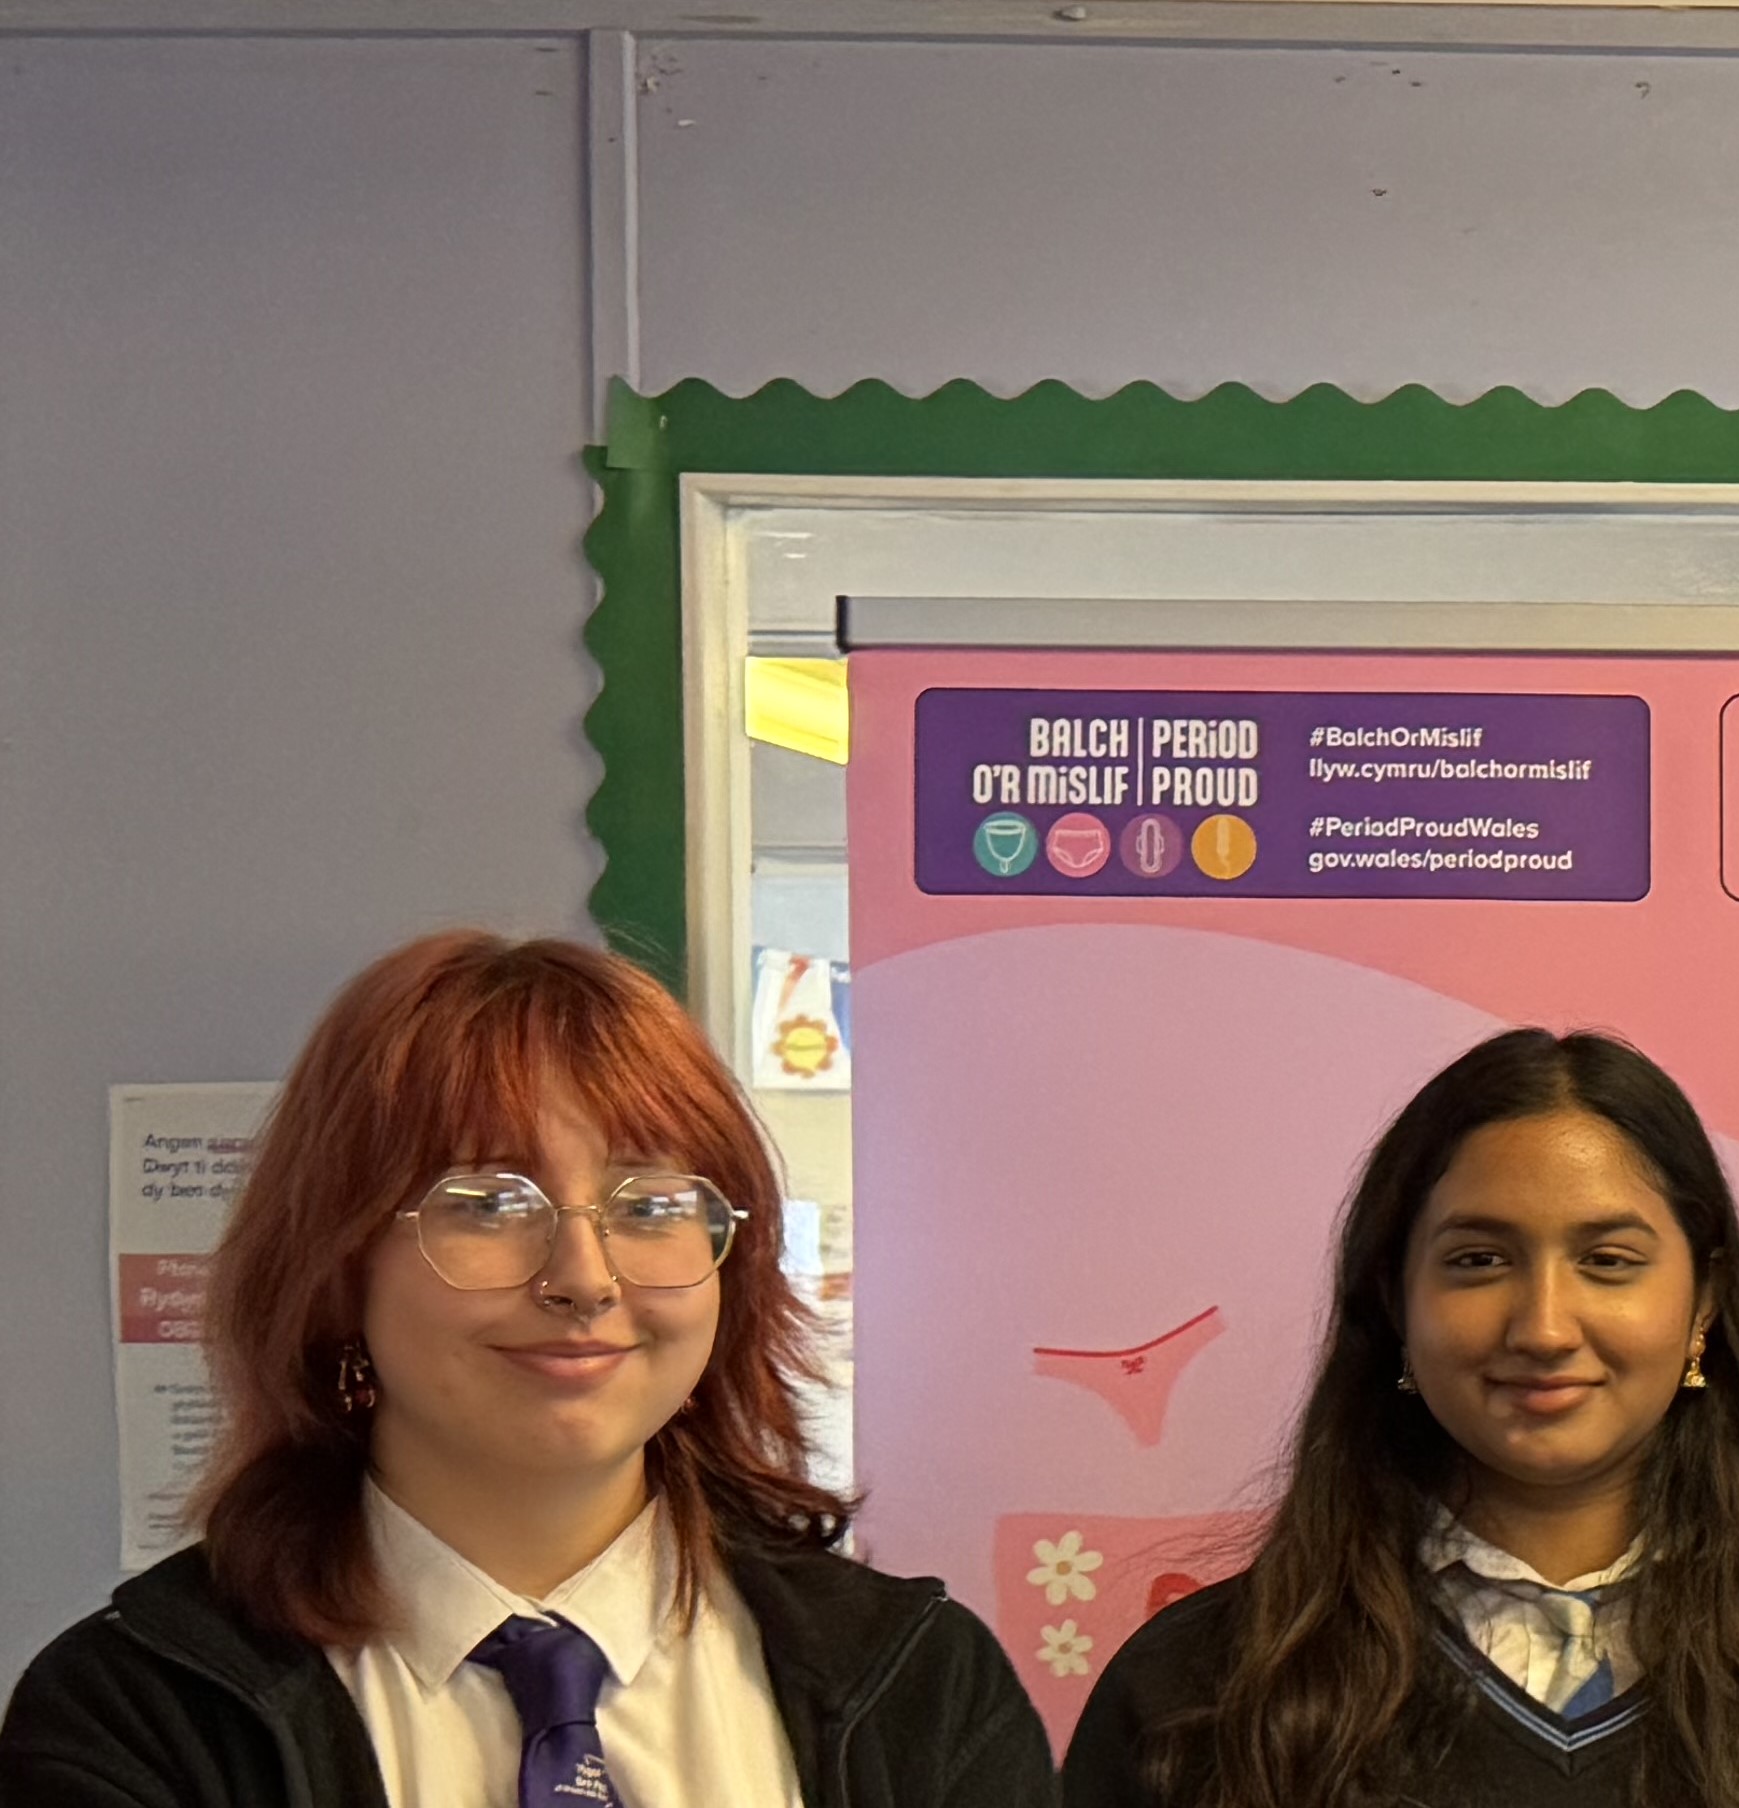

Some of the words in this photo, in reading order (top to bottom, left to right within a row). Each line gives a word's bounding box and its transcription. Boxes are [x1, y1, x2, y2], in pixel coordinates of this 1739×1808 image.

[1030, 718, 1128, 757] BALCH
[1310, 727, 1482, 747] #BalchOrMislif
[1310, 759, 1591, 782] llyw.cymru/balchormislif
[1152, 767, 1257, 806] PROUD
[1310, 817, 1539, 838] #PeriodProudWales
[1309, 849, 1572, 872] gov.wales/periodproud
